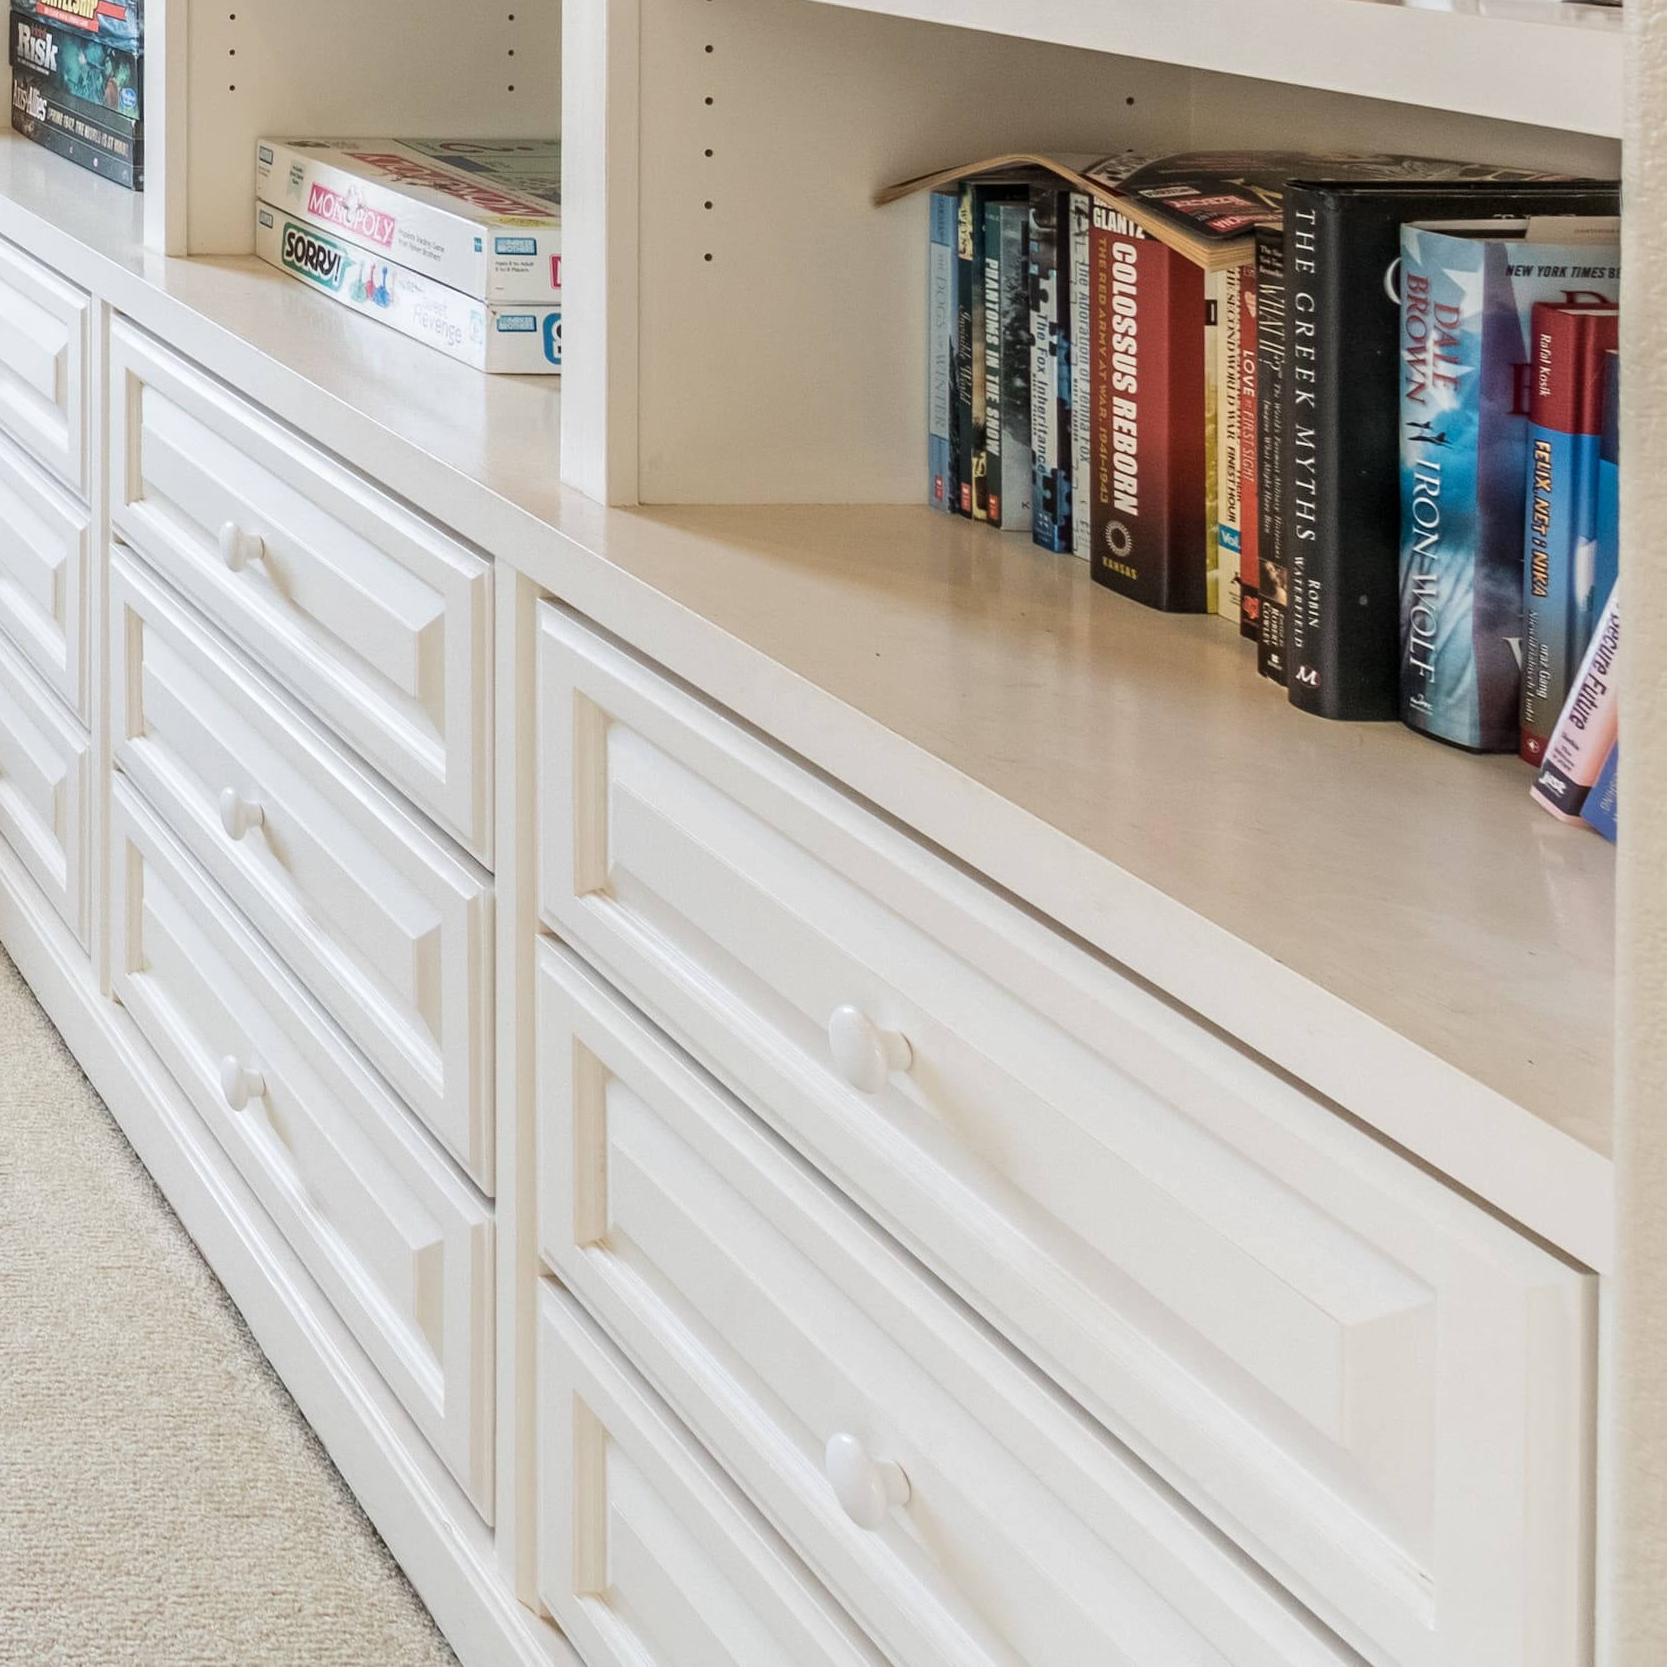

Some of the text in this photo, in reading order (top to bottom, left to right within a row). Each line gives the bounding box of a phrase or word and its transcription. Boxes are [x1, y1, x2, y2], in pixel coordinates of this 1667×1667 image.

[17, 22, 58, 73] Risk
[284, 230, 342, 283] SORRY!
[1098, 238, 1109, 271] THE
[1505, 264, 1605, 281] NEW YORK TIMES
[1098, 275, 1109, 304] RED
[983, 258, 1000, 457] PHANTOMS IN THE SNOW
[1098, 308, 1109, 356] ARMY
[1403, 274, 1429, 406] BROWN
[1430, 302, 1455, 388] DALE
[1036, 313, 1049, 473] The Fox Inheritance
[1098, 360, 1109, 380] AT
[1112, 240, 1139, 517] COLOSSUS REBORN
[1294, 209, 1321, 542] THE GREEK MYTHS
[1098, 385, 1109, 421] WAR,
[1225, 290, 1235, 522] SECOND WORLD WAR FINEST HOUR
[1529, 497, 1549, 533] NET
[1102, 556, 1138, 582] KANSAS
[1408, 457, 1442, 679] IRON WOLF
[1528, 551, 1548, 596] NIKA
[1293, 556, 1307, 649] WATERFIELD
[1307, 577, 1321, 629] ROBIN
